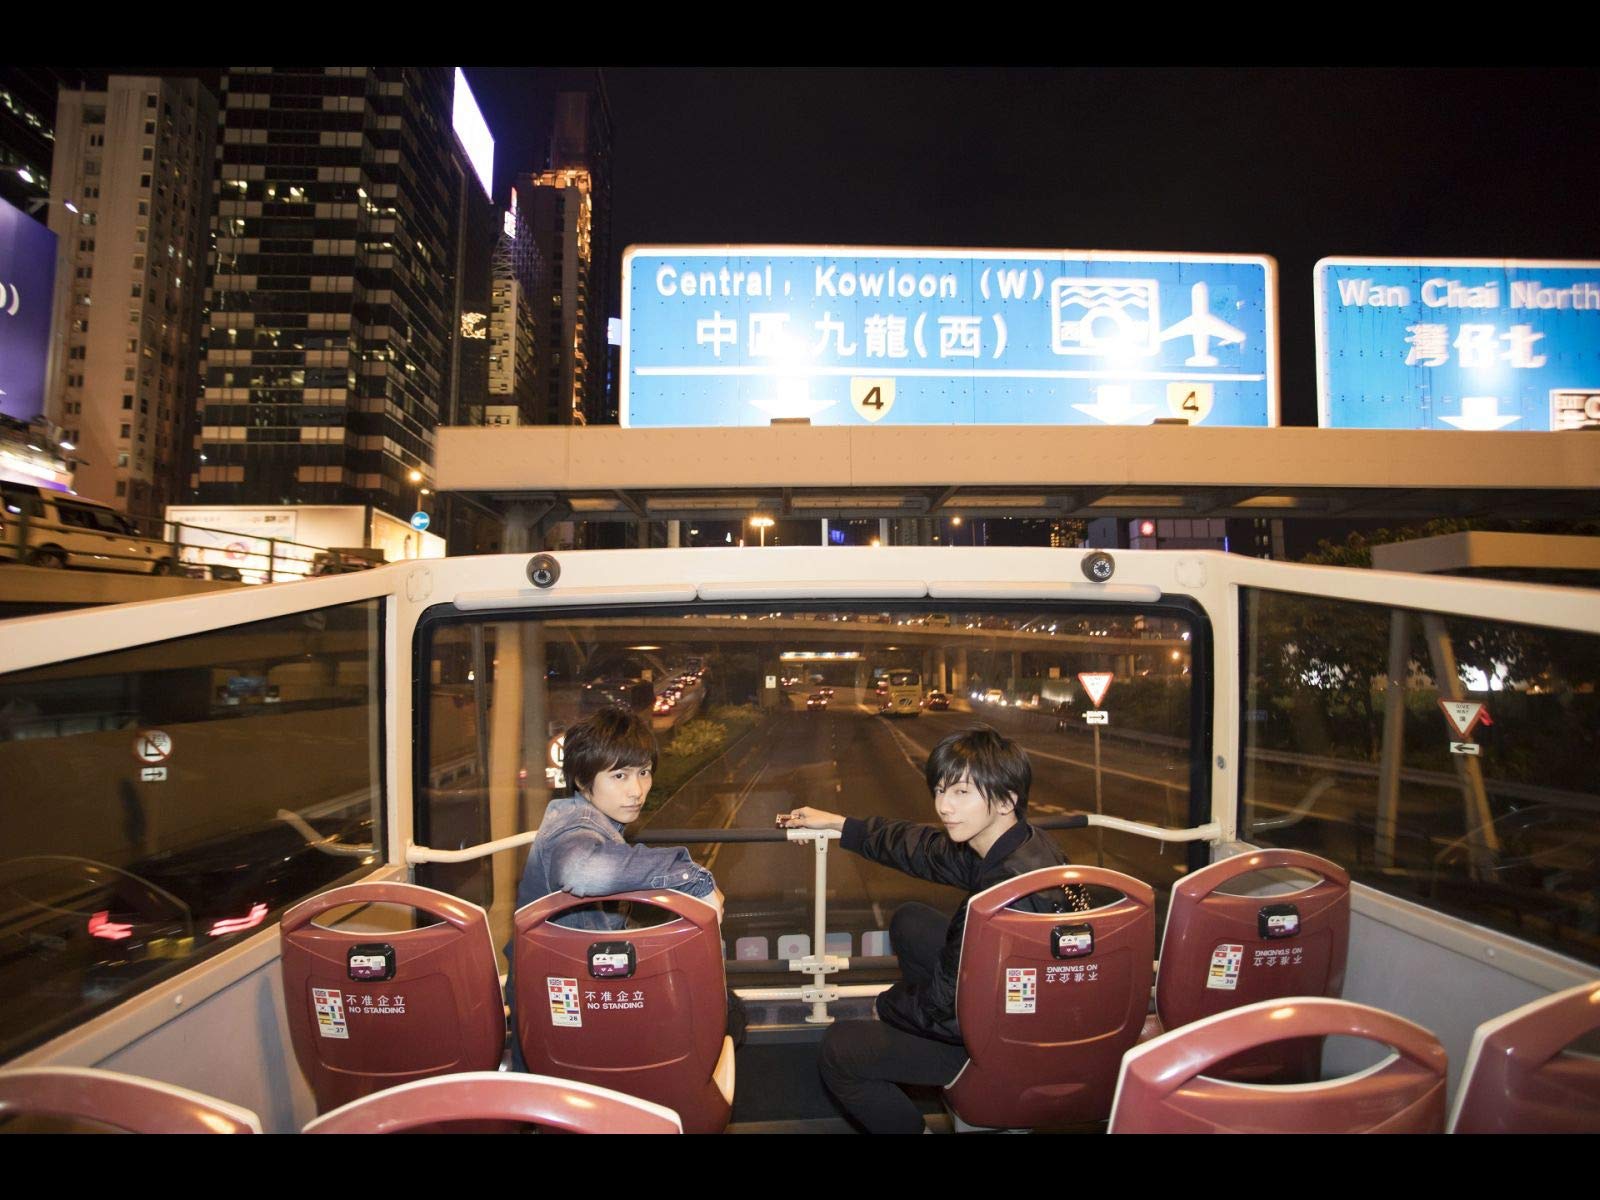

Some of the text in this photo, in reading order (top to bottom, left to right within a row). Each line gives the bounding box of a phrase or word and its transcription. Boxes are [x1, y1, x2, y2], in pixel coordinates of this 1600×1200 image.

[815, 265, 957, 298] Kowloon
[980, 267, 1044, 299] (W)
[1337, 278, 1600, 309] Wan Chai North
[862, 386, 884, 410] 4
[1182, 391, 1199, 411] 4
[1255, 949, 1290, 957] STANDING
[1046, 965, 1084, 973] STANDING
[1045, 972, 1098, 983] 不准企立
[346, 994, 405, 1006] 不准企立
[584, 990, 644, 1002] 不准企立
